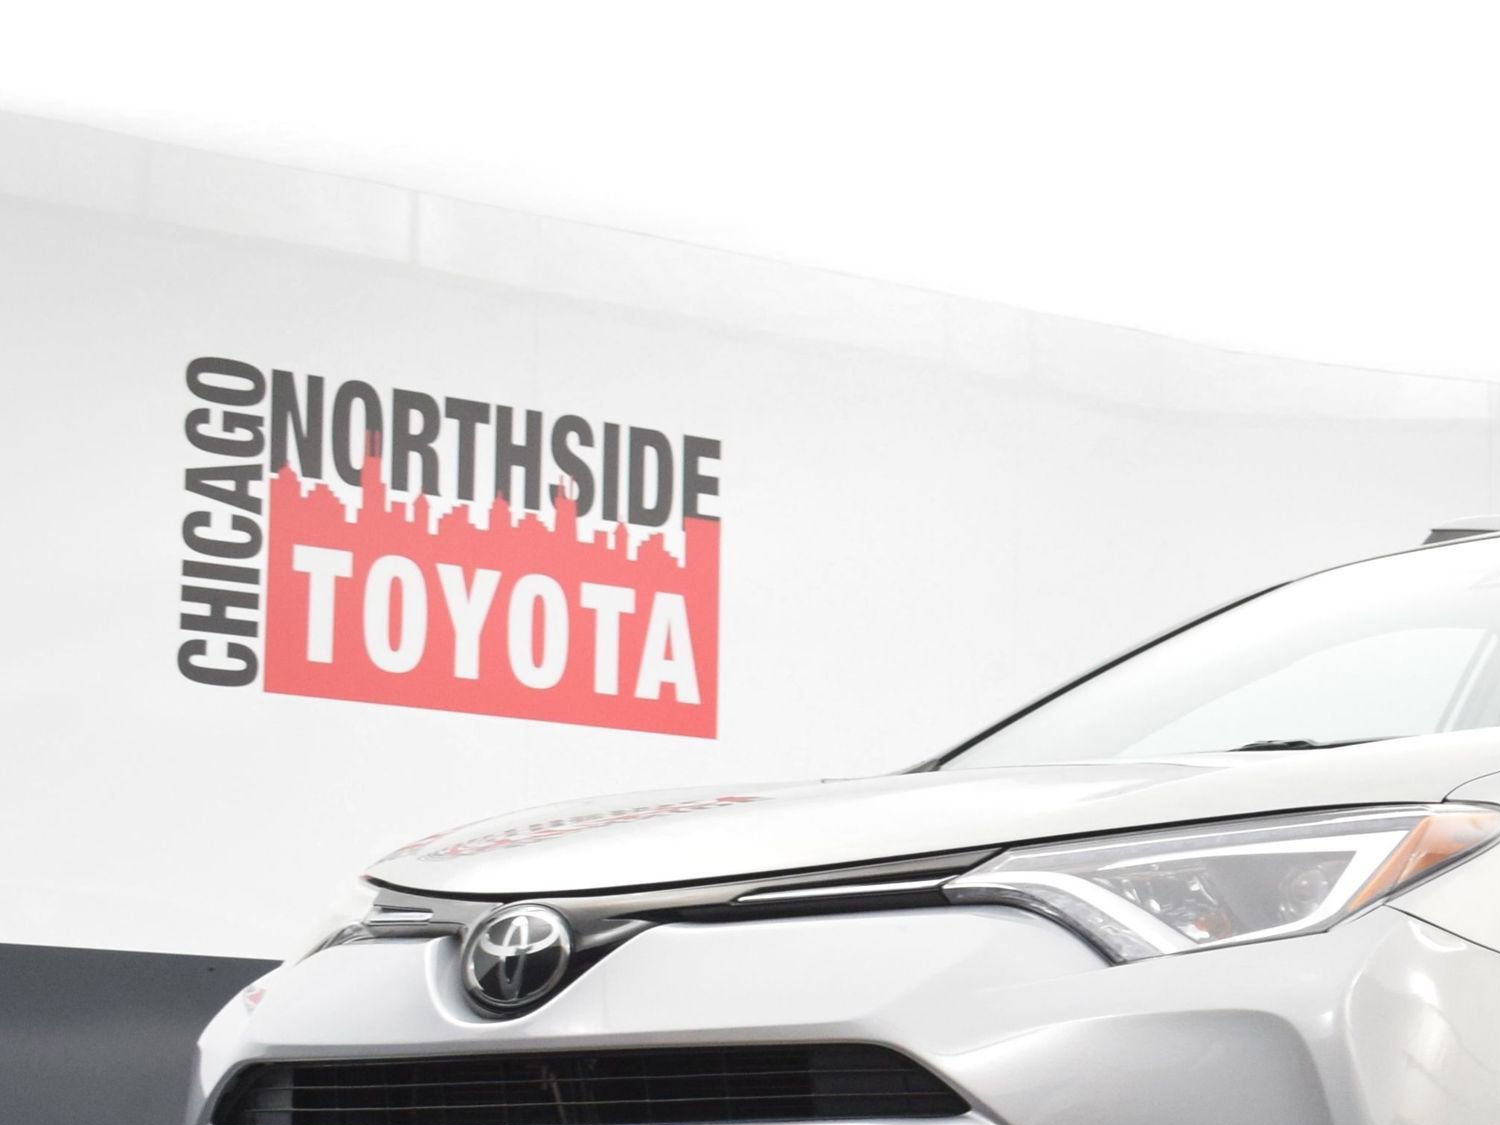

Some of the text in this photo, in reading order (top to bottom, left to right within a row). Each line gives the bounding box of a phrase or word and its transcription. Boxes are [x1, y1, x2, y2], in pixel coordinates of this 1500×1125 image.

[177, 356, 266, 687] CHICAGO
[270, 369, 722, 532] NORTHSIDE
[292, 544, 700, 704] TOYOTA
